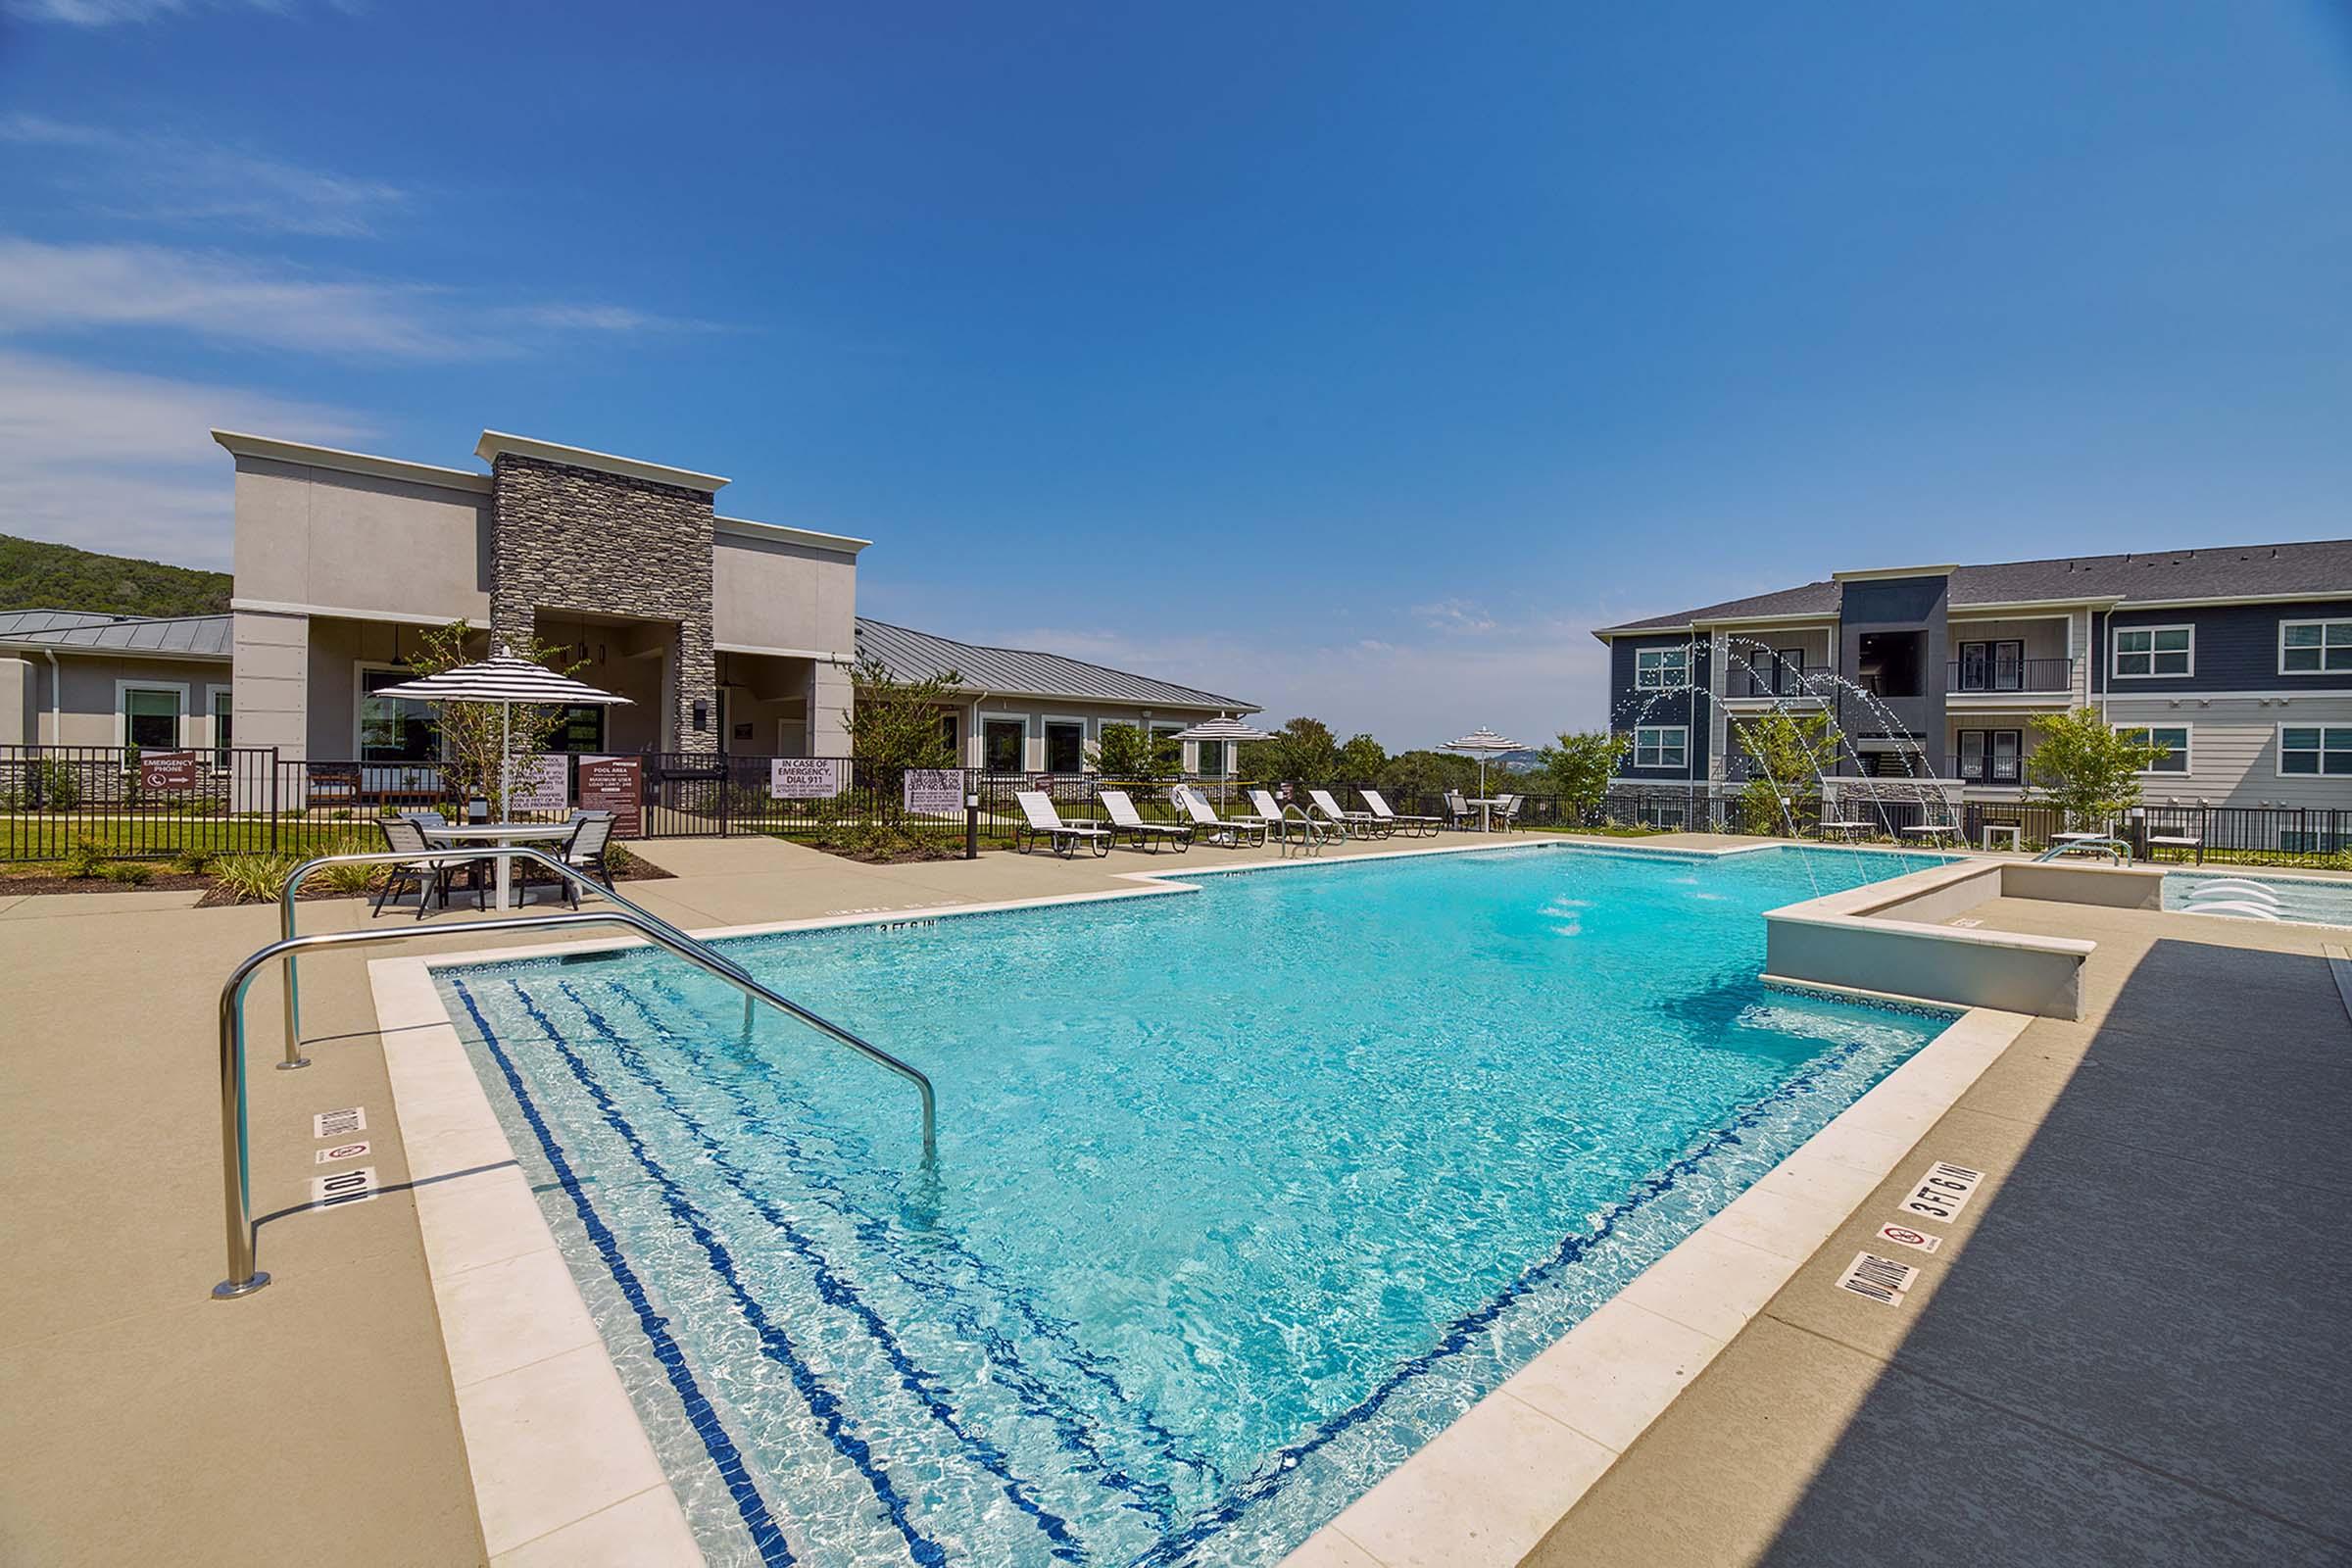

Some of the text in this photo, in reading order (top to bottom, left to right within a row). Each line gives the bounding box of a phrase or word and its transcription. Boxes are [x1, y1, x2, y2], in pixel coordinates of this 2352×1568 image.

[323, 1171, 368, 1206] 10 IN
[1909, 1163, 1979, 1217] 3 FT 6 IN
[1844, 1255, 1910, 1302] NO DIVING
